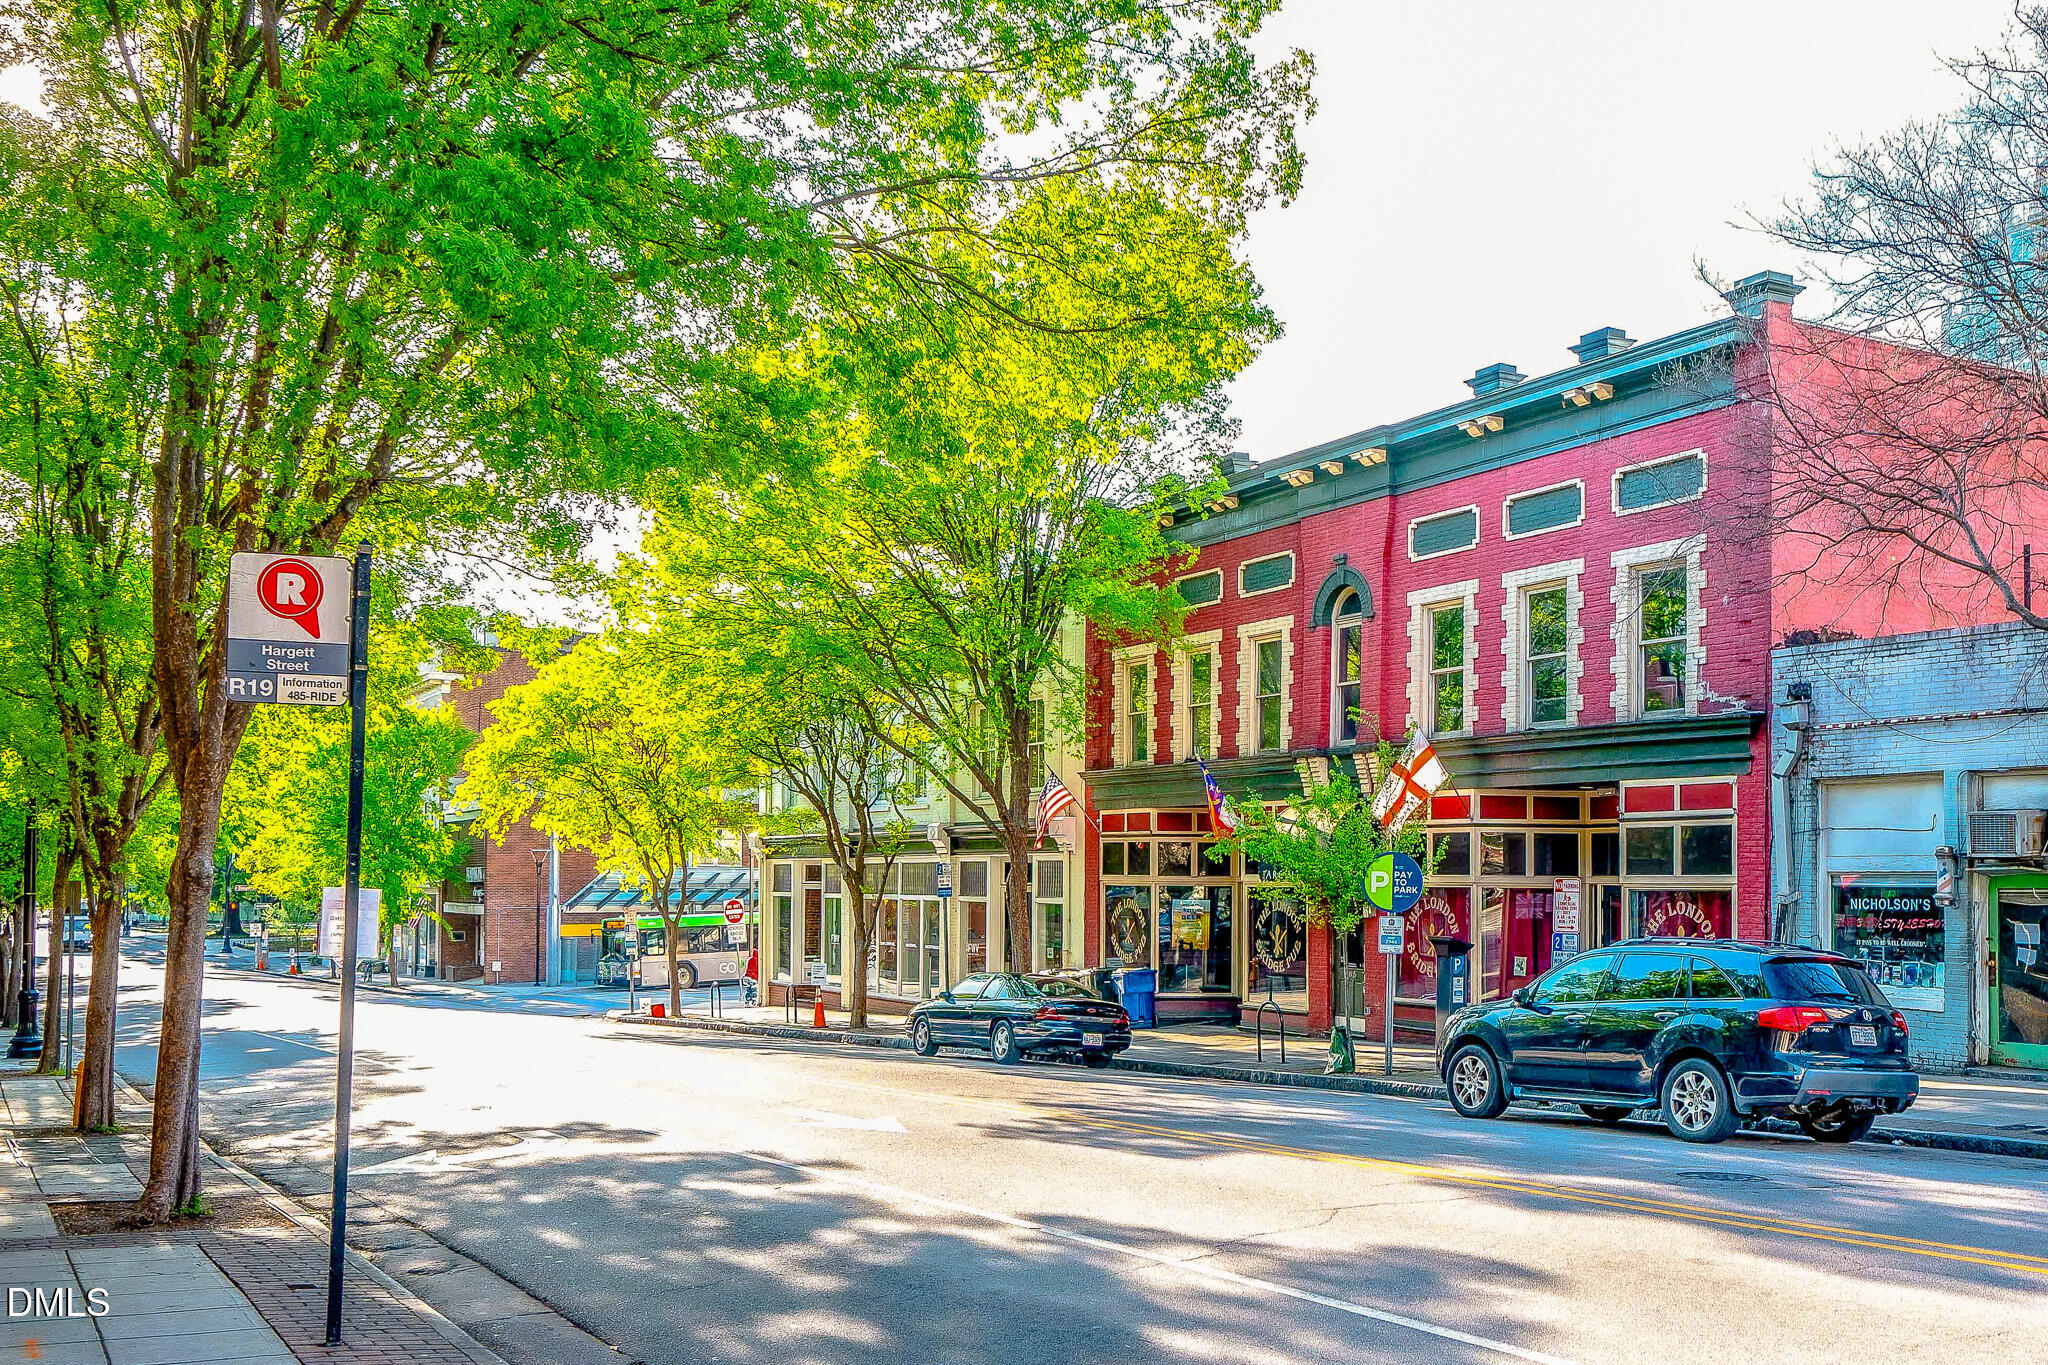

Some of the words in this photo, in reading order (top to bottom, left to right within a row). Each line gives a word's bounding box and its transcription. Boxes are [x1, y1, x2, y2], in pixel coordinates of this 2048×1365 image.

[276, 572, 307, 606] R
[261, 644, 315, 658] Hargett
[266, 659, 310, 672] Street
[229, 677, 274, 696] R19
[282, 677, 343, 689] Information
[287, 690, 337, 702] 485-RIDE
[1394, 871, 1413, 879] PAY
[1371, 871, 1389, 893] P
[1394, 878, 1407, 886] TO
[1394, 886, 1418, 894] PARK
[1850, 898, 1931, 911] NICHOLSON'S
[1123, 898, 1146, 929] LONDON
[1255, 905, 1272, 931] THE
[1272, 900, 1302, 934] LONDON
[1405, 903, 1423, 932] THE
[1423, 897, 1460, 935] LONDON
[1555, 936, 1560, 949] 2
[1255, 939, 1286, 973] BRIDGE
[1286, 940, 1302, 969] PUB
[1406, 941, 1437, 978] BRIDG
[719, 962, 737, 974] GO
[1454, 958, 1461, 971] P
